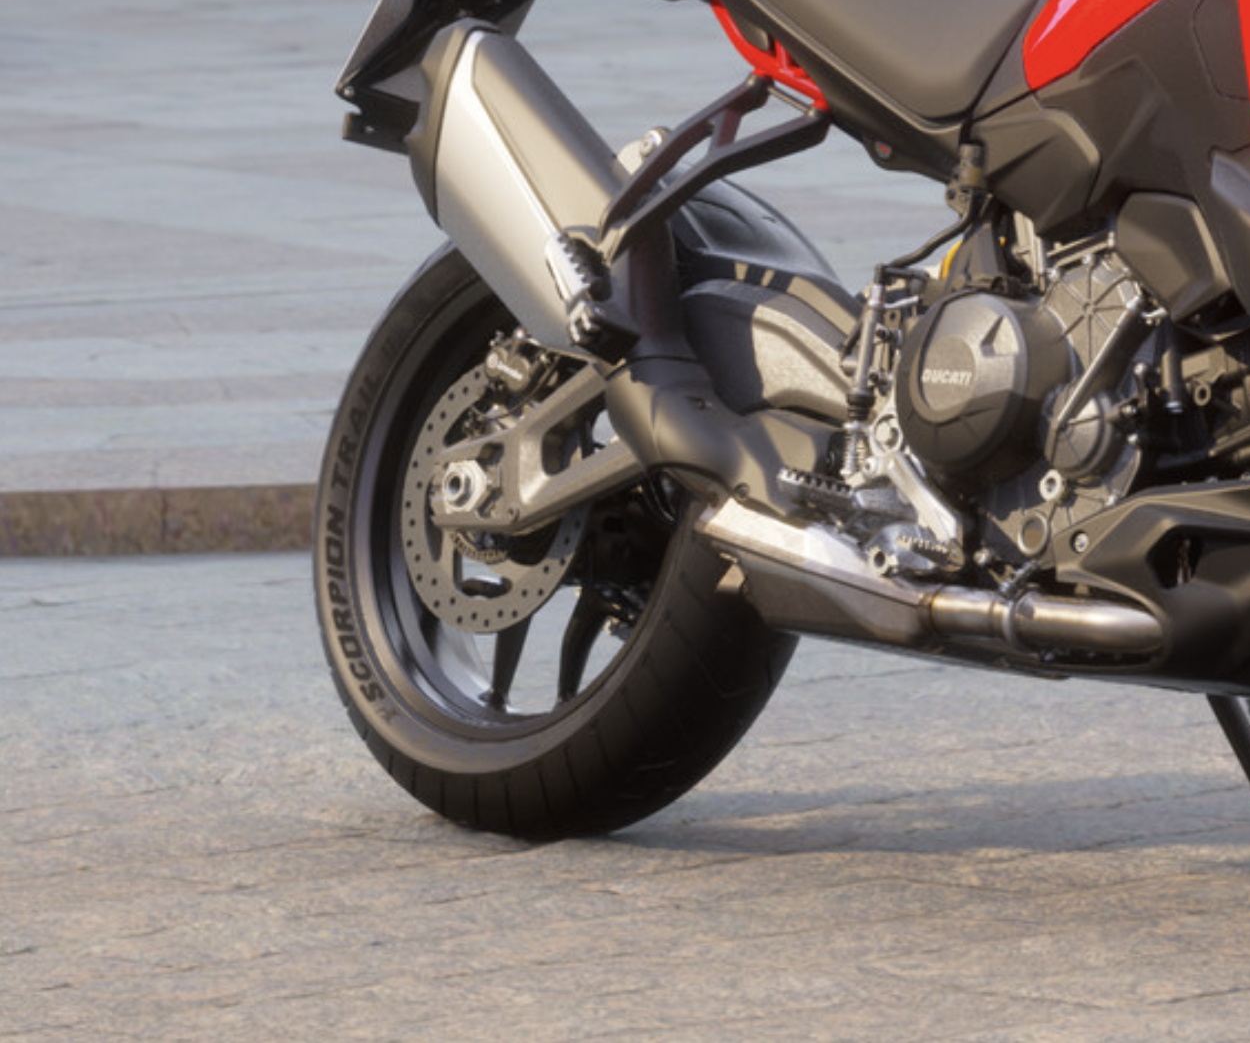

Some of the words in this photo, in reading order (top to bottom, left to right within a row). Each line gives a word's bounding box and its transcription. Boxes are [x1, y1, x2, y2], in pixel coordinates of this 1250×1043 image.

[332, 374, 381, 490] TRAIL
[922, 368, 972, 385] DUCATI
[326, 504, 384, 701] SCORPION
